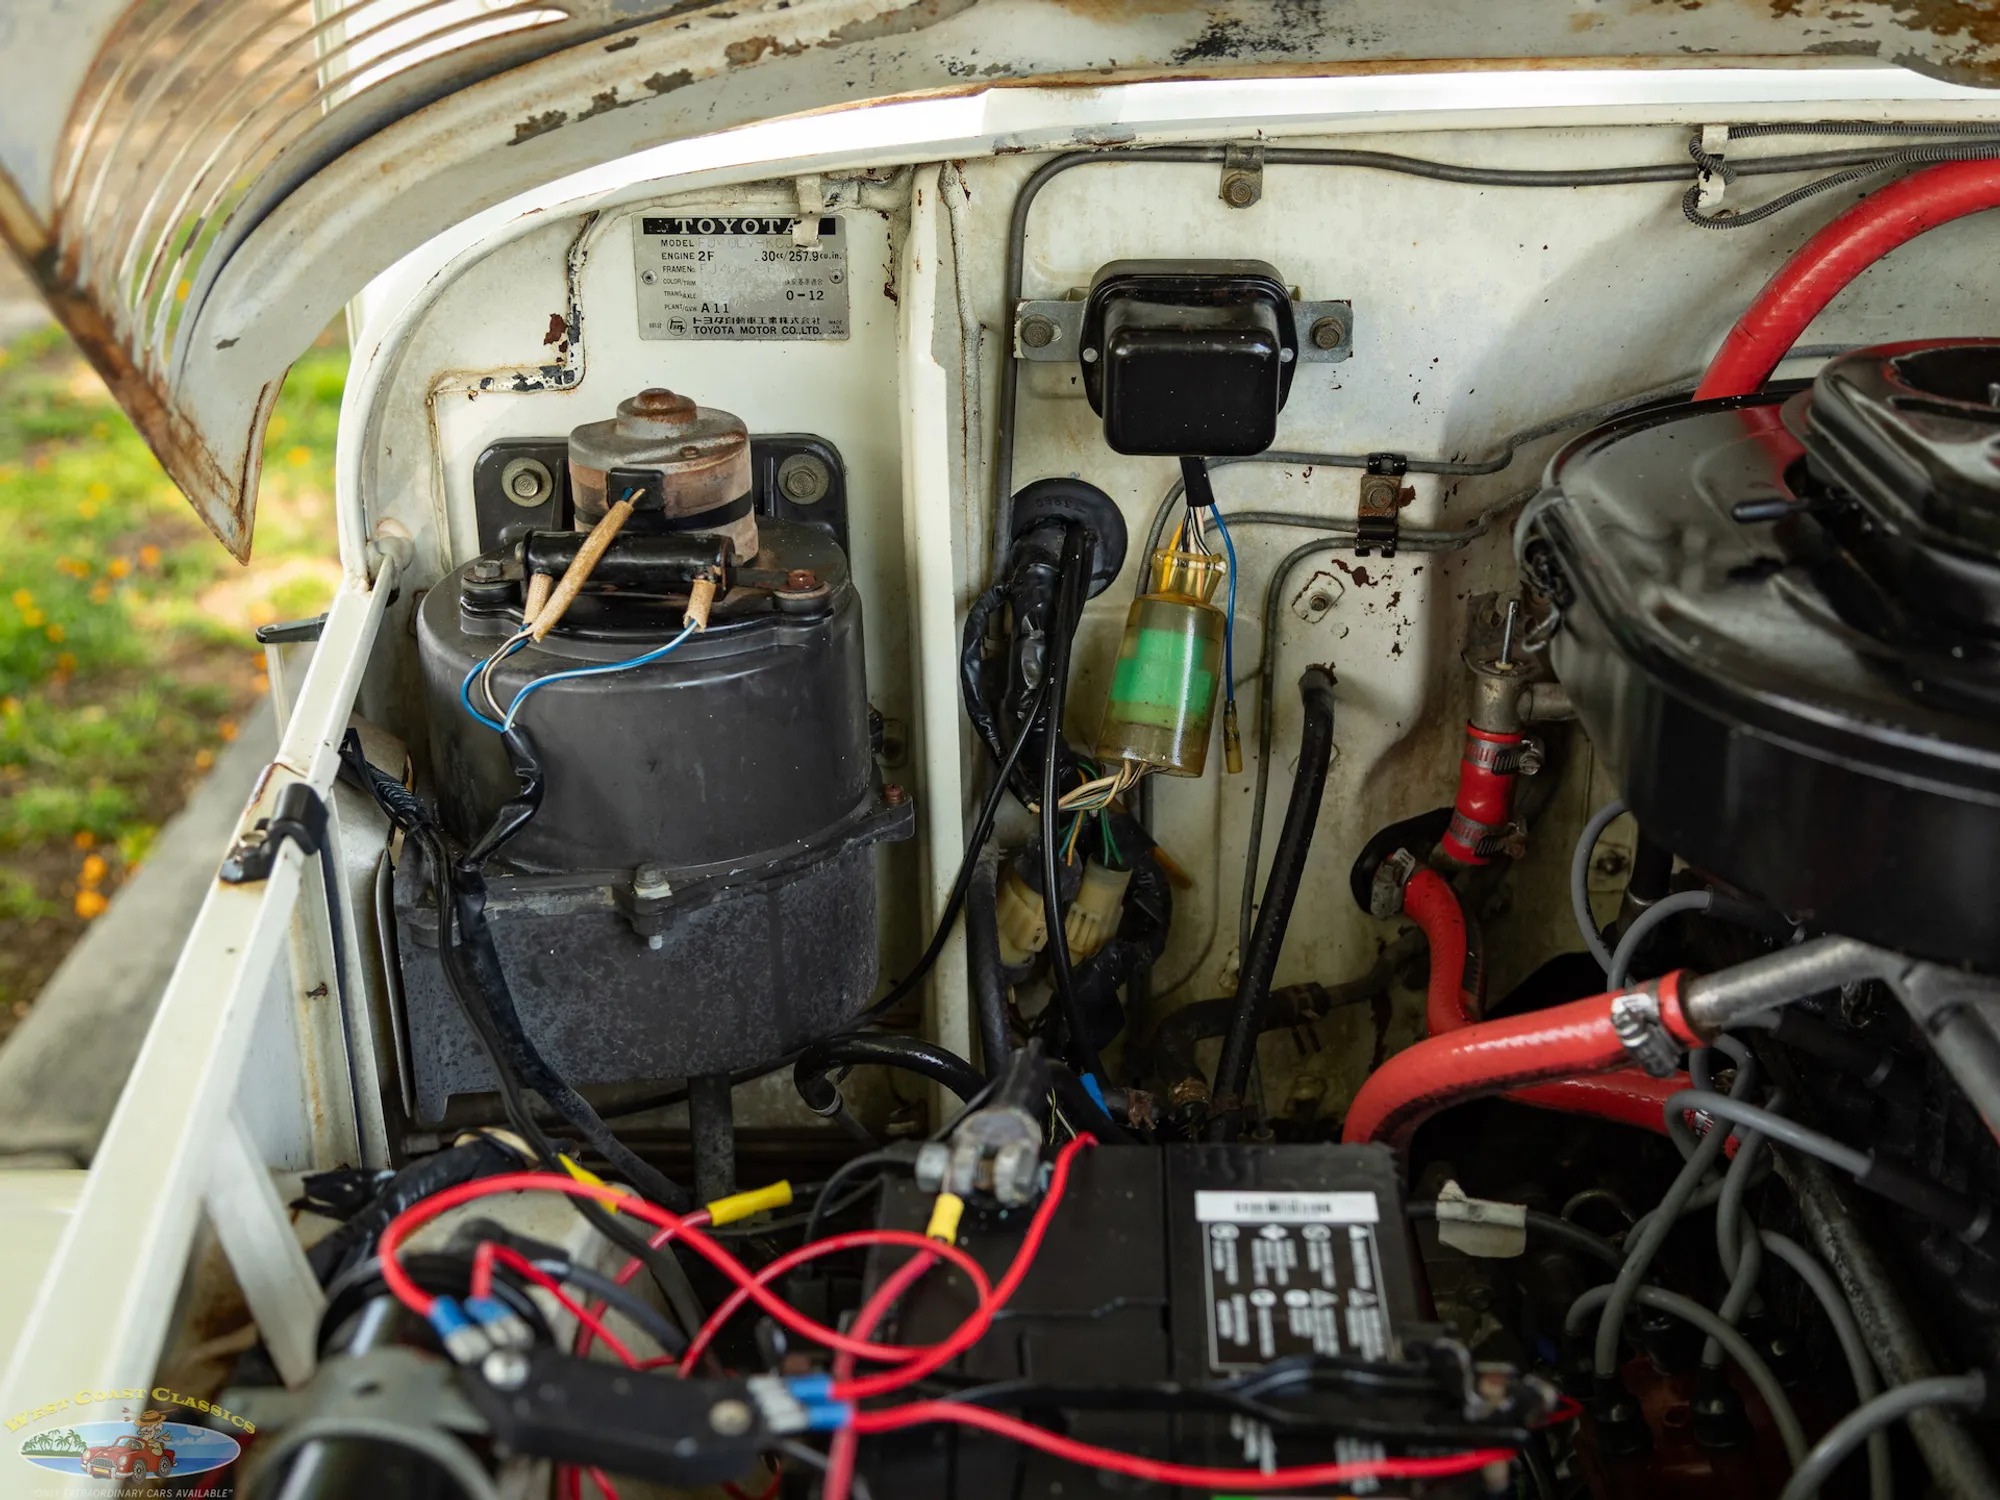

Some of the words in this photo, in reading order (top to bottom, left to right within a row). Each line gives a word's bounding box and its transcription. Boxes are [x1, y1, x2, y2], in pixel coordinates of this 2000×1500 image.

[660, 239, 695, 247] MODEL
[661, 252, 695, 260] ENGINE
[698, 251, 714, 262] 2F
[693, 326, 735, 335] TOYOTA
[740, 326, 777, 335] MOTOR
